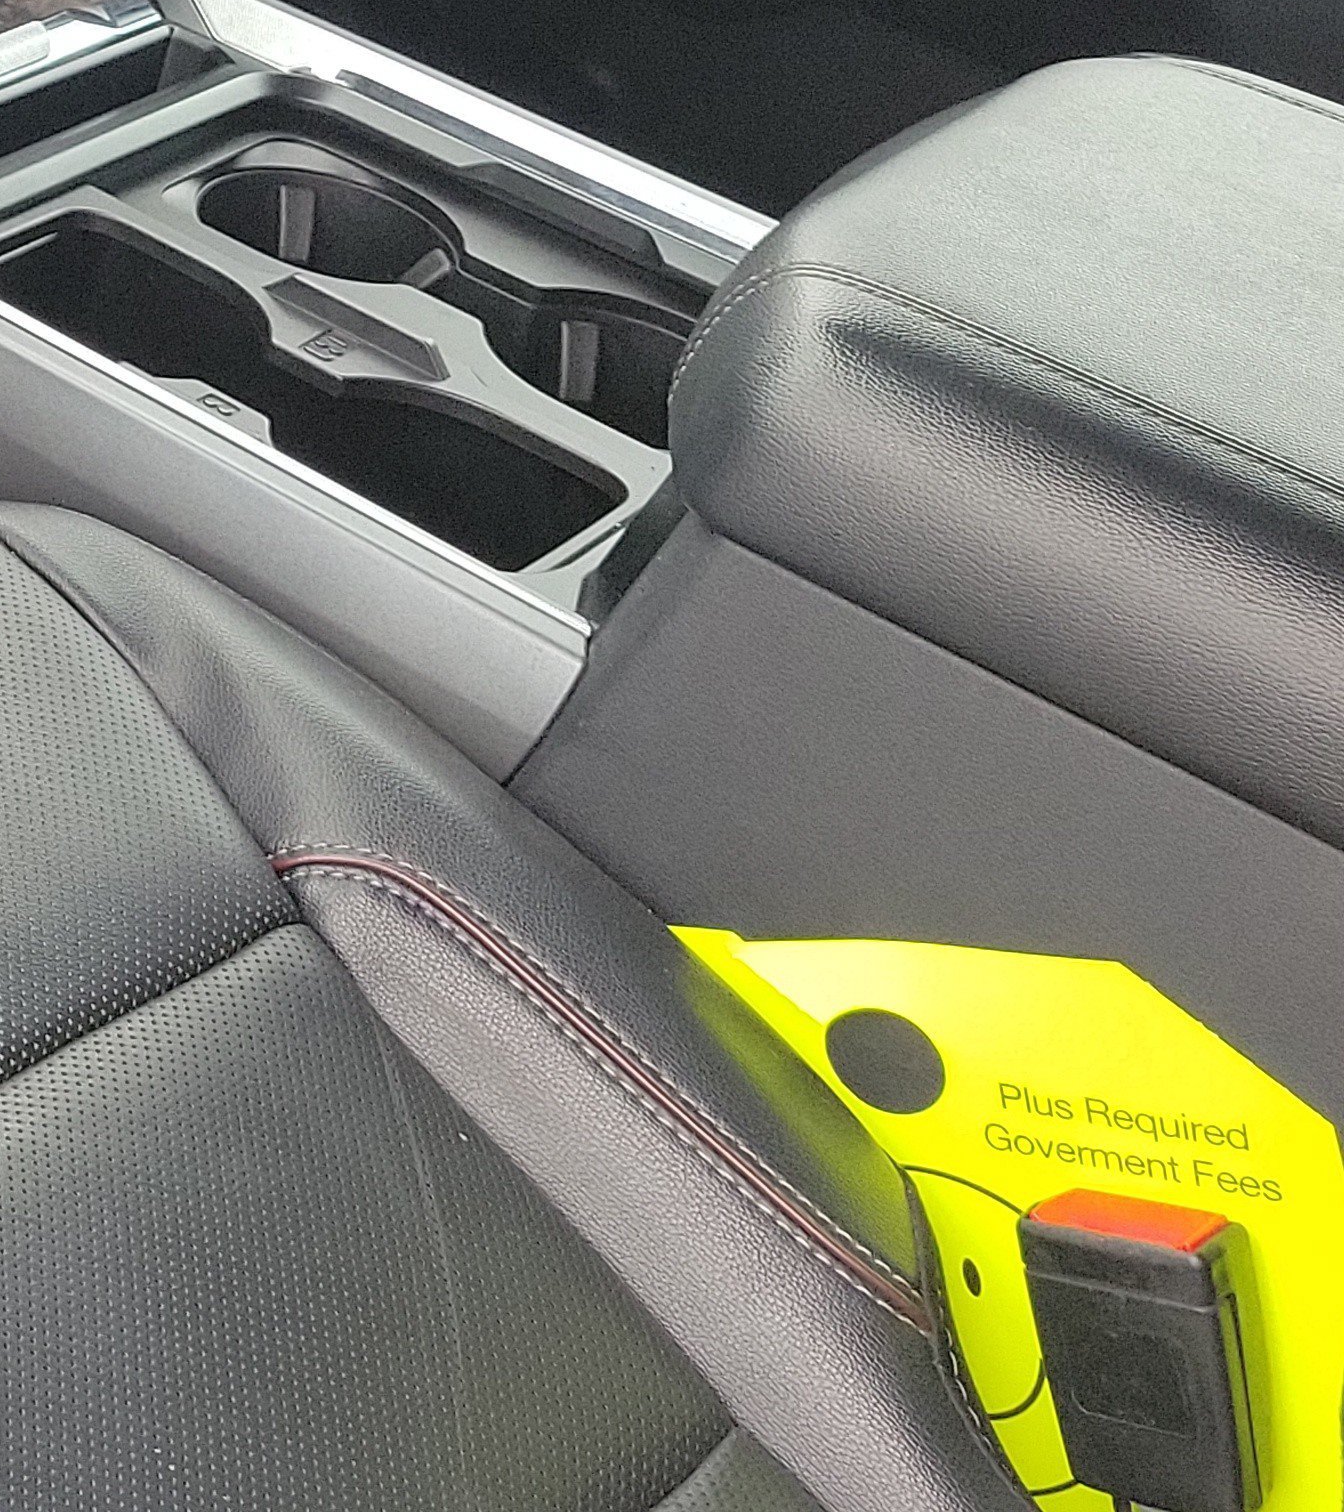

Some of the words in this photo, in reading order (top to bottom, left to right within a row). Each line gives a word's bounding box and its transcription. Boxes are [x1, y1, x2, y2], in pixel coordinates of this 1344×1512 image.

[999, 1082, 1075, 1121] Plus
[1084, 1096, 1250, 1152] Required
[1193, 1159, 1284, 1203] Fees
